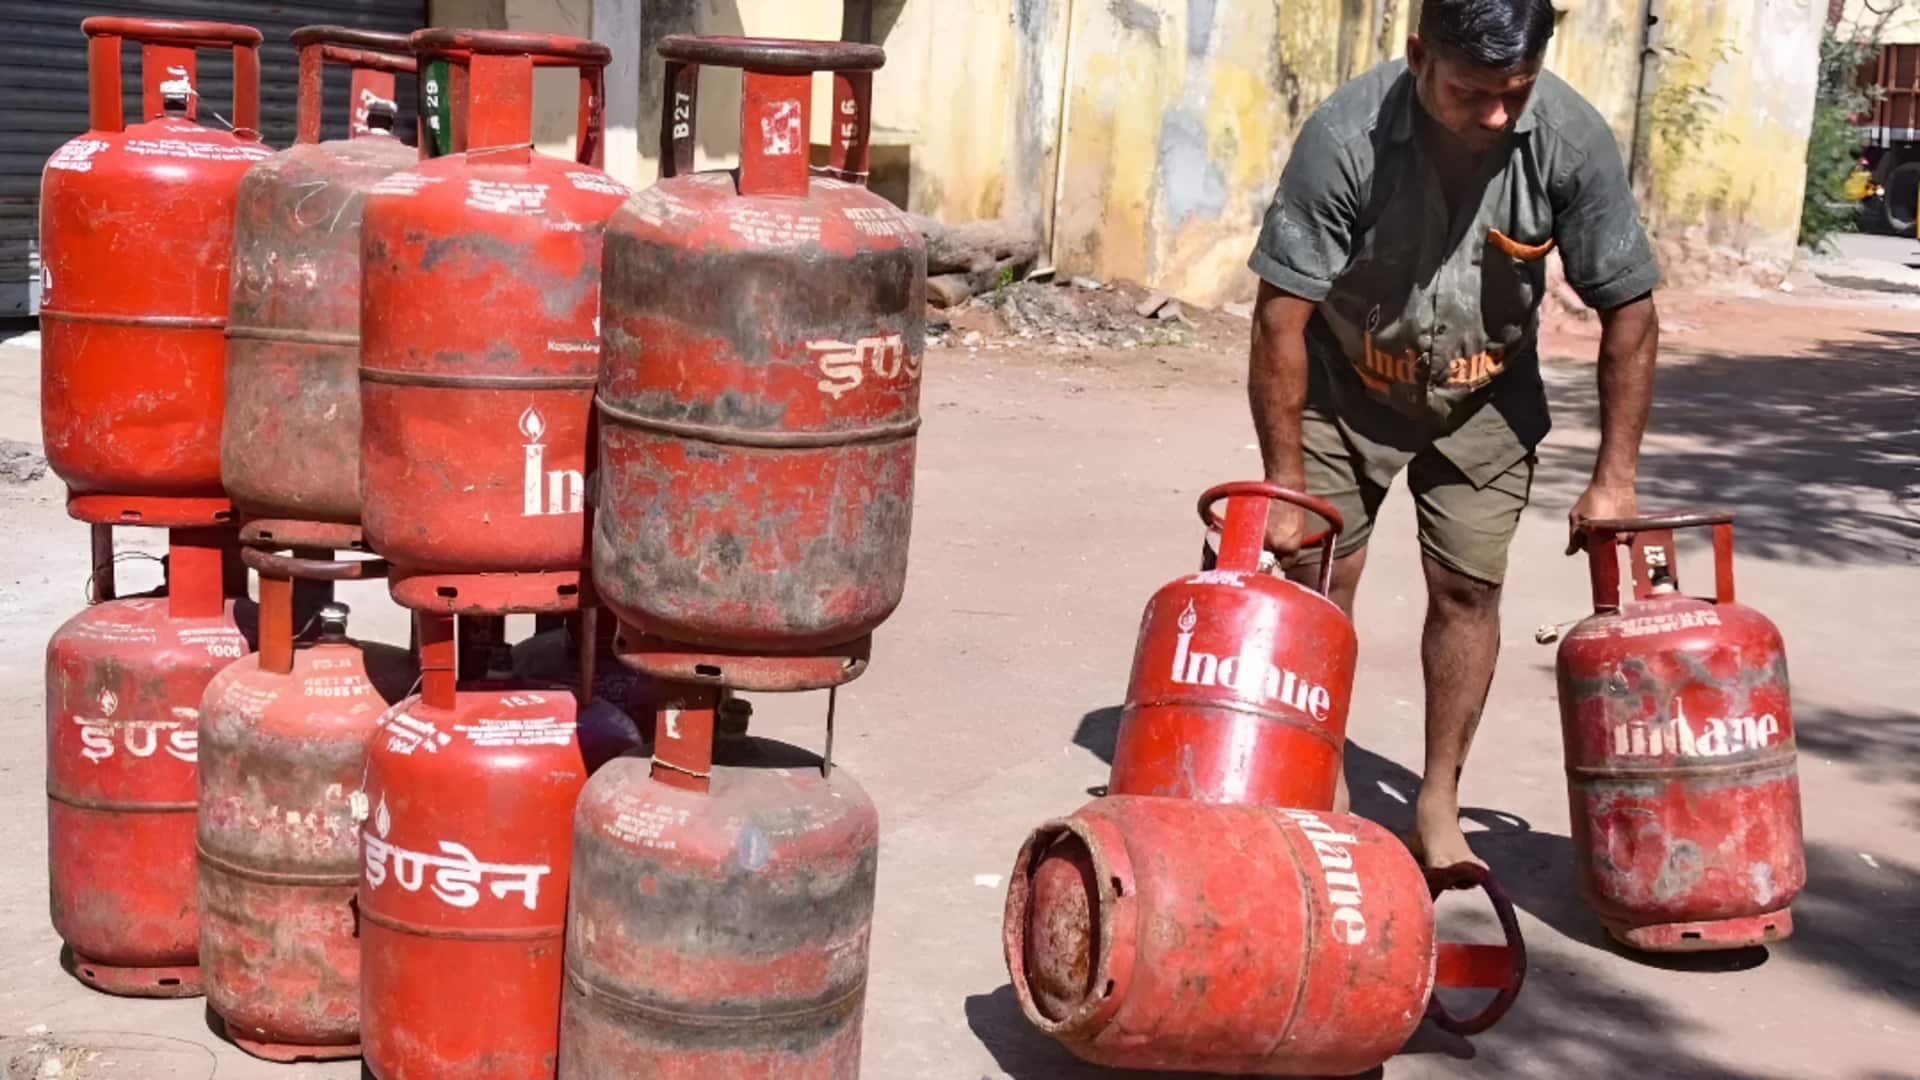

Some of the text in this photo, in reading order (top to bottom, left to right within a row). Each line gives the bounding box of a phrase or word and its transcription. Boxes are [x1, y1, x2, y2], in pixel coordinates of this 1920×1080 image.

[427, 79, 440, 108] 29
[673, 92, 690, 140] B27
[363, 831, 551, 911] इण्डेन
[1278, 807, 1367, 945] ndane
